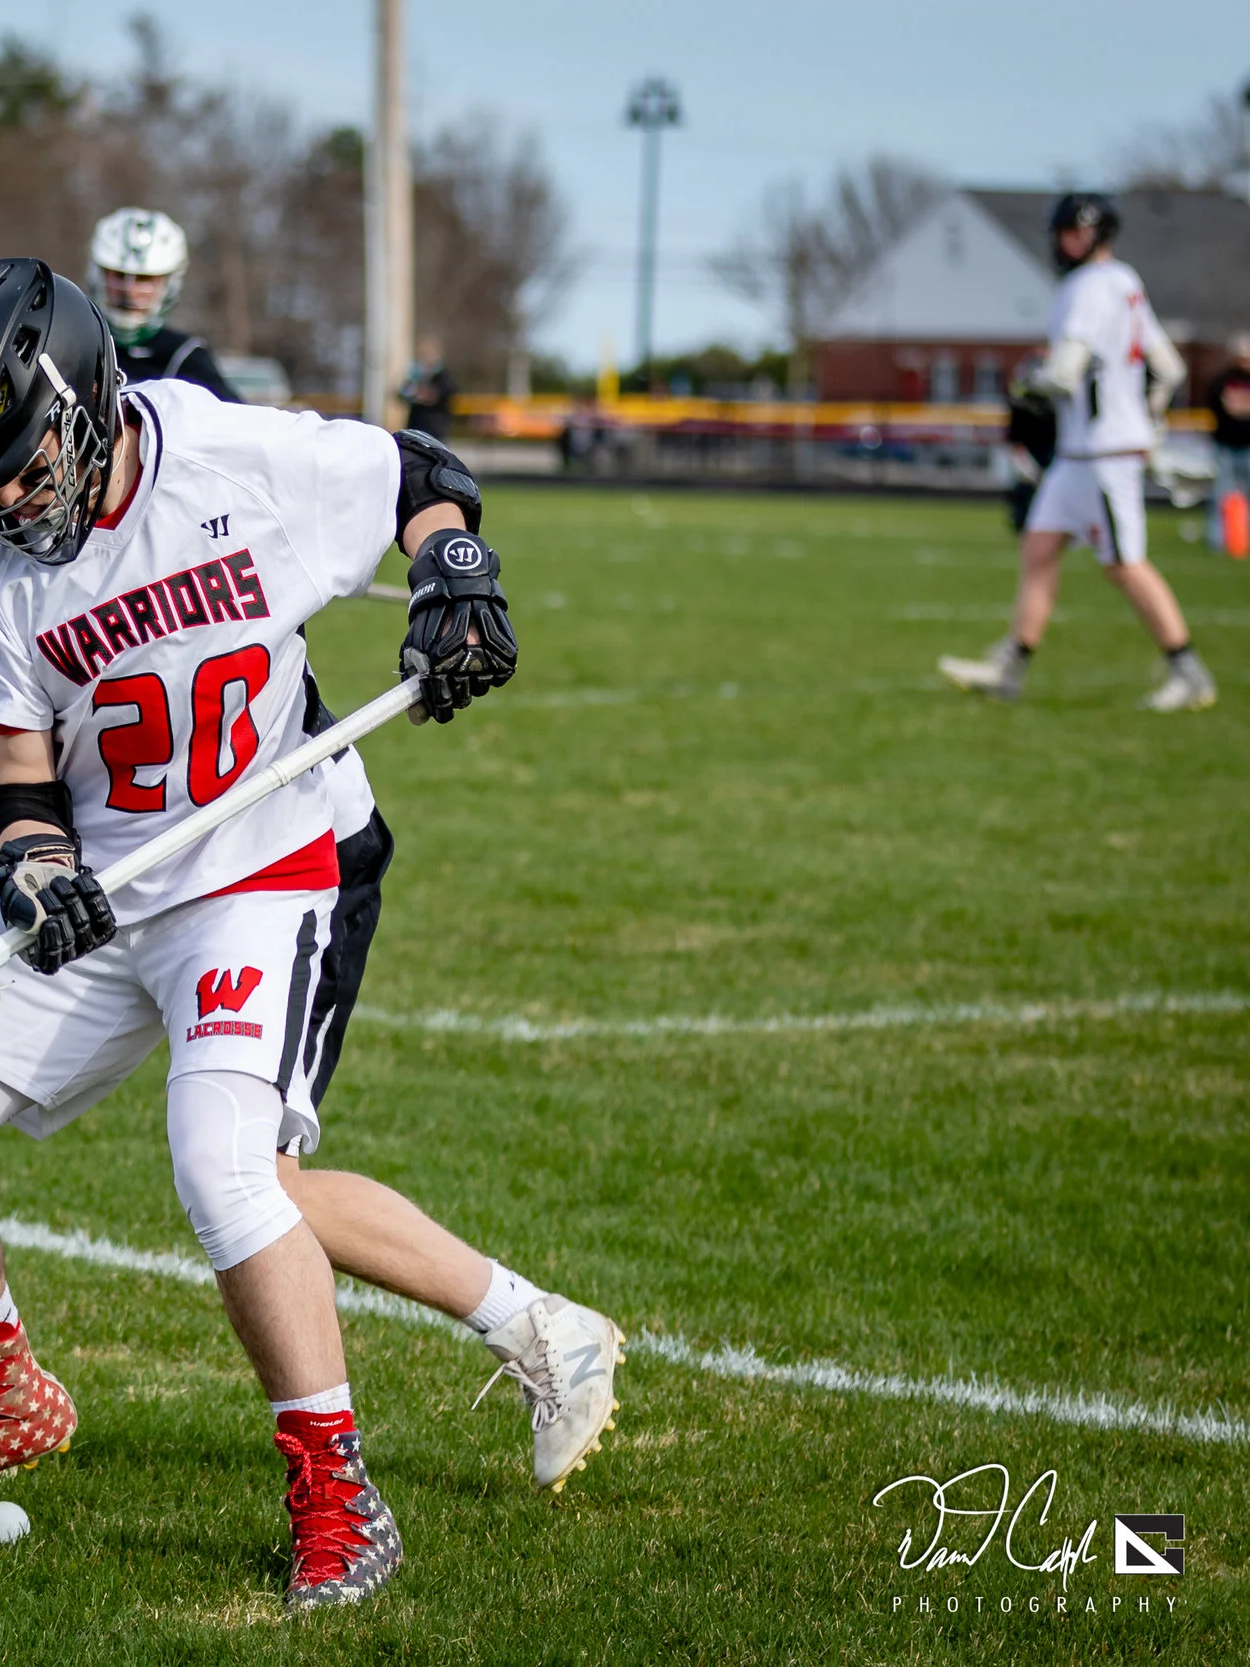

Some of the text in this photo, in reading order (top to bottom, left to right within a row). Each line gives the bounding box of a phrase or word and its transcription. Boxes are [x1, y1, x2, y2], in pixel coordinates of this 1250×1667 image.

[36, 548, 271, 688] WARRIORS
[92, 642, 271, 814] 20
[186, 1020, 264, 1043] LACROSSE
[196, 965, 264, 1021] W
